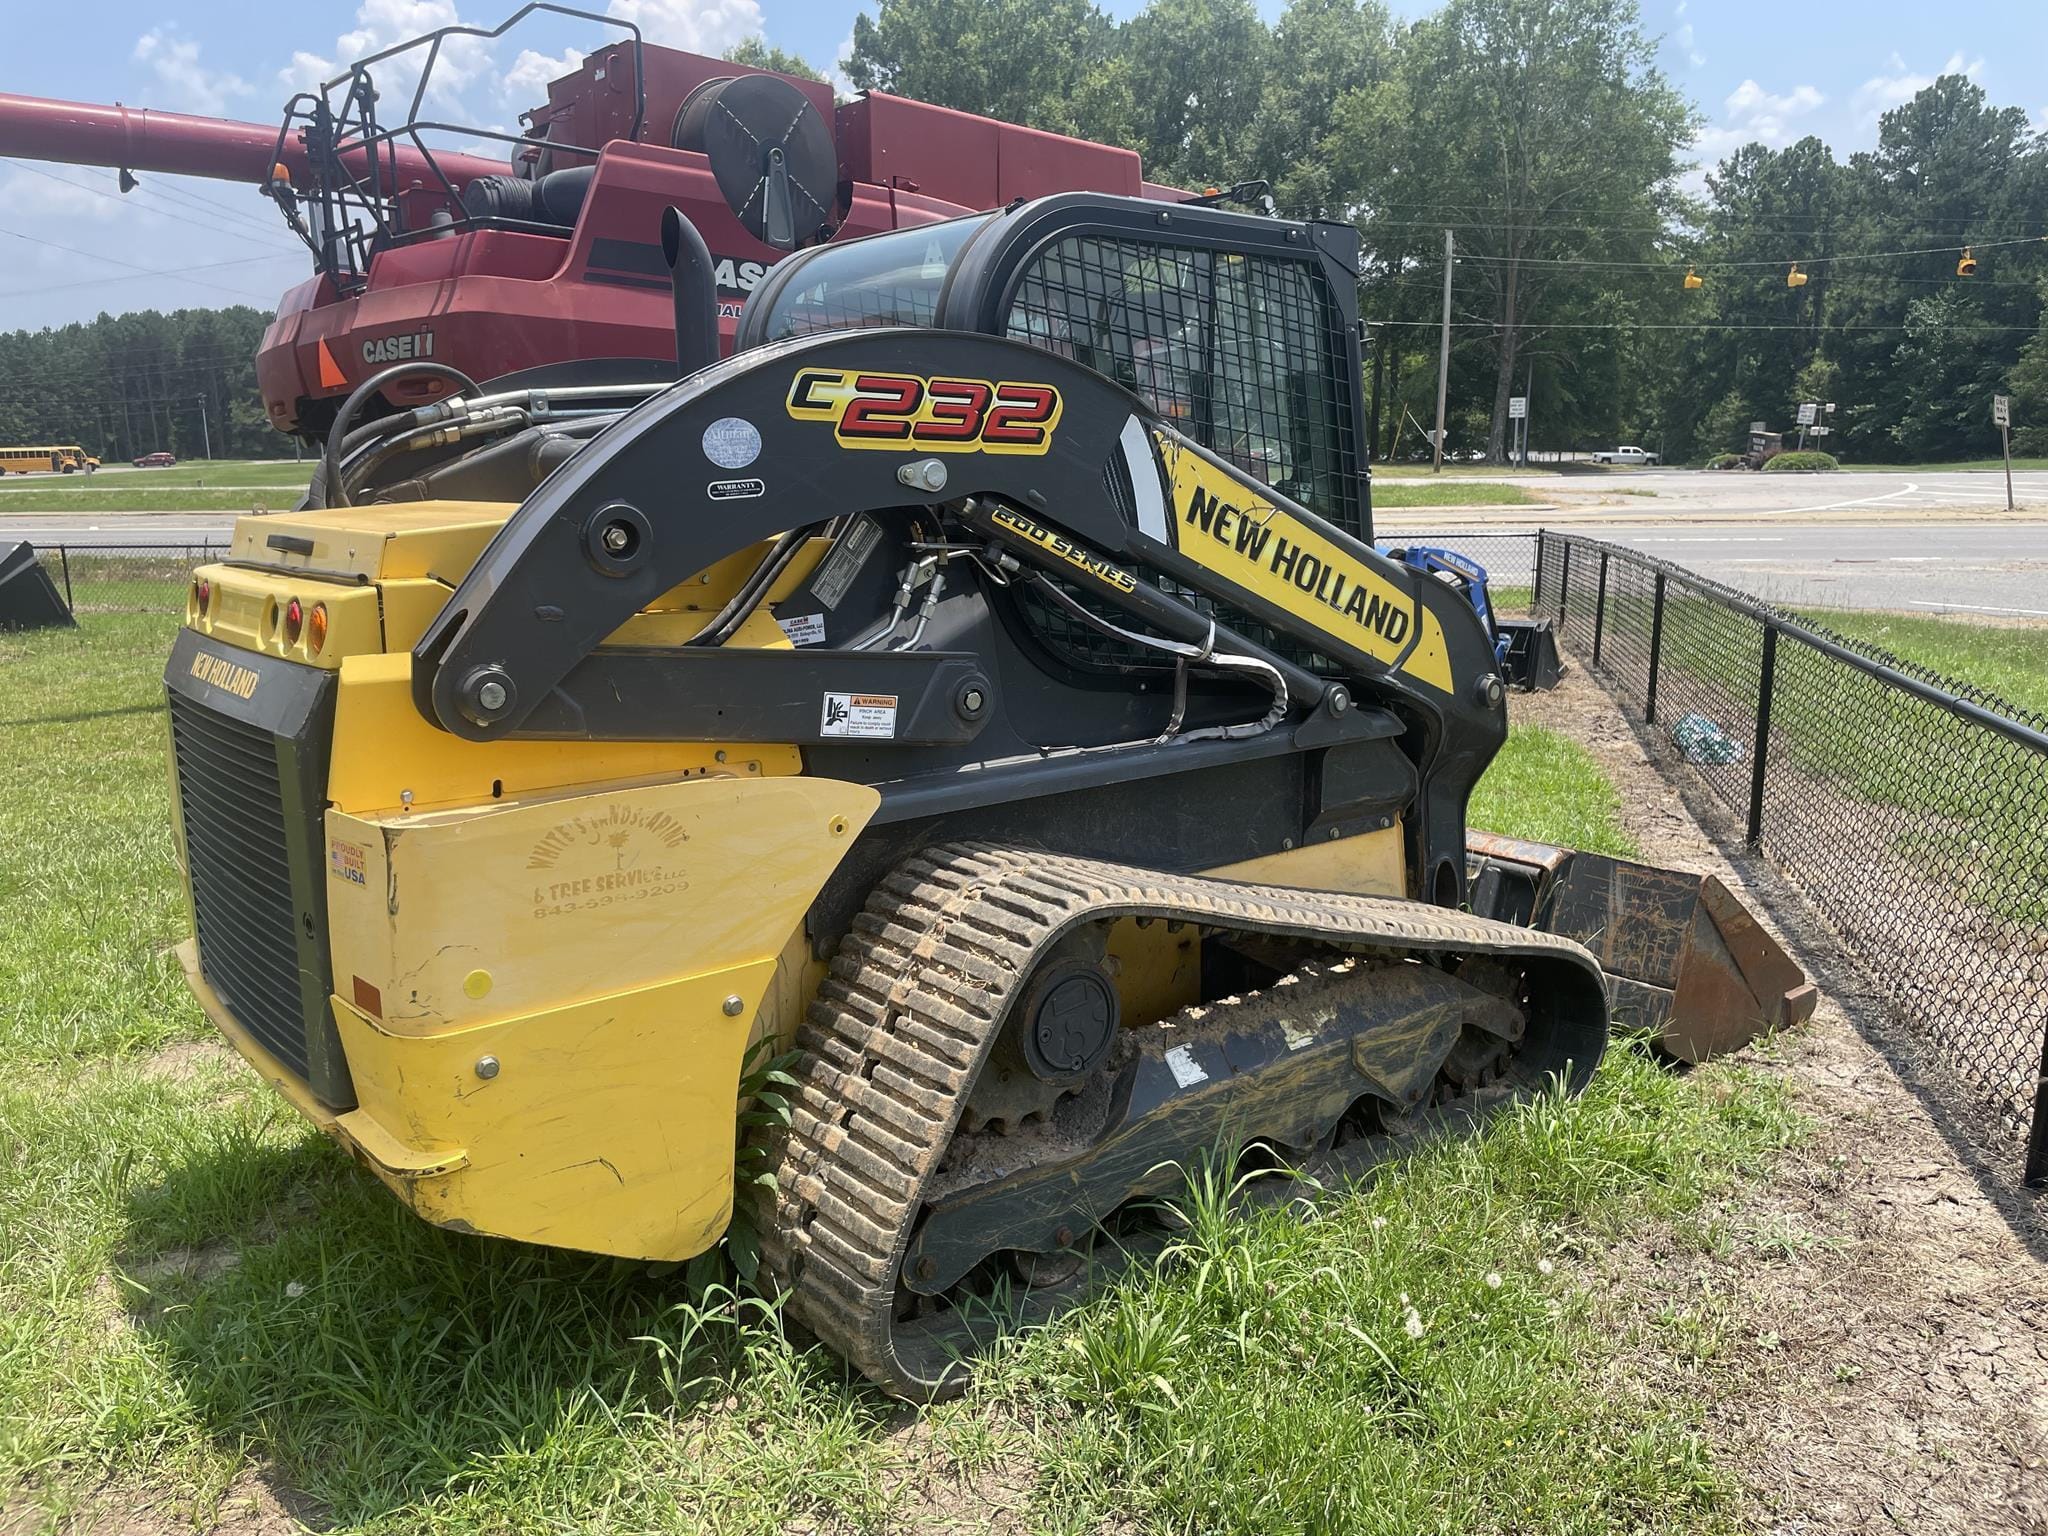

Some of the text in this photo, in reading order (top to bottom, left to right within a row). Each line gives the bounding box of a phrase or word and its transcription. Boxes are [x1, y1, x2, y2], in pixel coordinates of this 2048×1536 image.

[715, 259, 776, 291] AS
[362, 335, 412, 364] CASE
[788, 369, 1062, 454] C232
[1996, 398, 2007, 407] ONE
[716, 482, 755, 491] WARRANTY
[993, 507, 1136, 591] 200 SERIES
[1185, 485, 1410, 645] NEW HOLLAND
[1443, 551, 1479, 577] NEW HOLLAND
[190, 651, 258, 699] NEW HOLLAND
[861, 698, 893, 706] WARNING
[331, 838, 365, 859] PROUDLY
[344, 855, 365, 871] BUILT
[344, 866, 366, 885] USA
[549, 878, 592, 901] TREE
[663, 869, 688, 881] LLC
